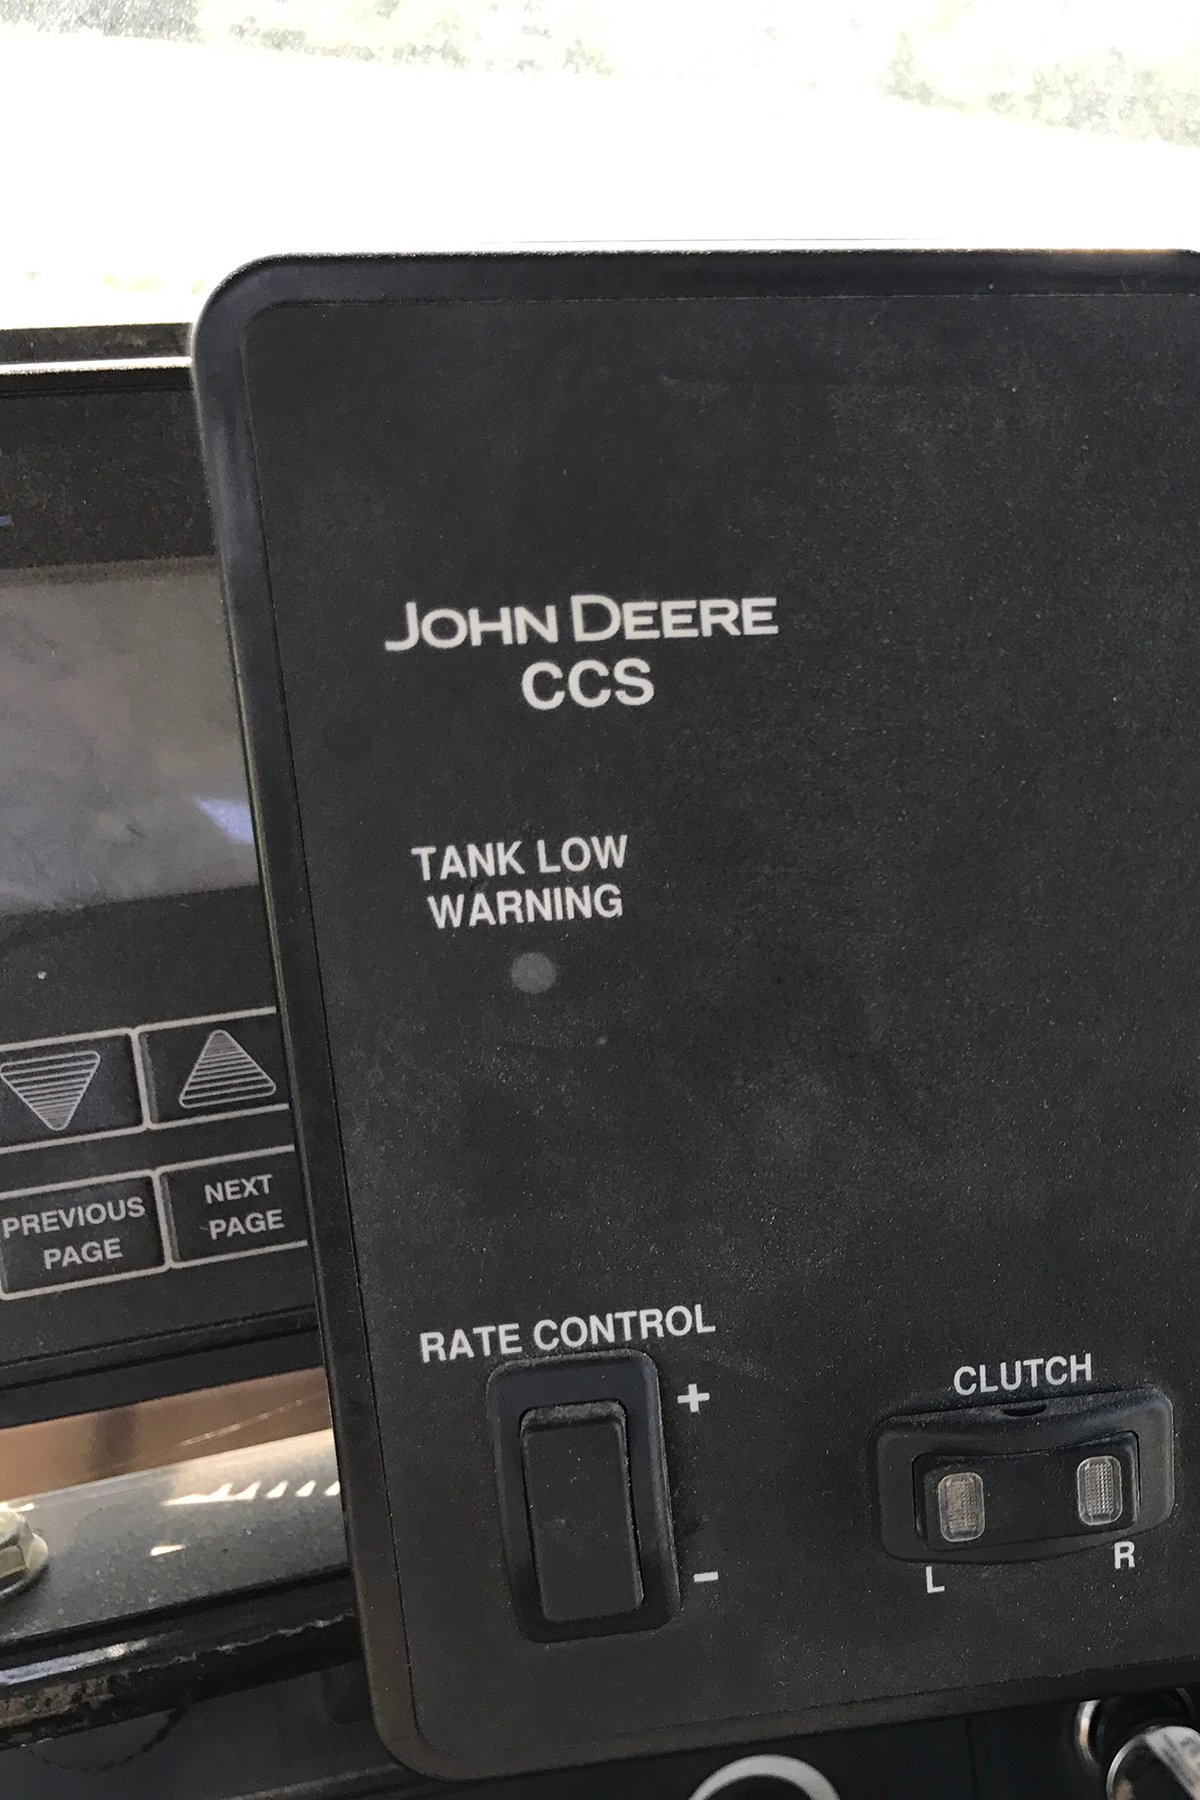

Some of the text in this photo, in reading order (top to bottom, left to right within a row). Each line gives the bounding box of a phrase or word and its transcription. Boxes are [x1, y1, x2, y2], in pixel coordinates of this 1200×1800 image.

[384, 594, 779, 652] JOHN DEERE
[521, 657, 656, 711] CCS
[410, 833, 629, 883] TANK LOW
[426, 883, 624, 930] WARNING
[203, 1172, 274, 1205] NEXT
[1, 1195, 147, 1241] PREVIOUS
[208, 1208, 286, 1242] PAGE
[43, 1236, 123, 1272] PAGE
[418, 1303, 717, 1364] RATE CONTROL
[953, 1351, 1093, 1397] CLUTCH
[1113, 1540, 1137, 1571] R
[925, 1565, 946, 1595] L
